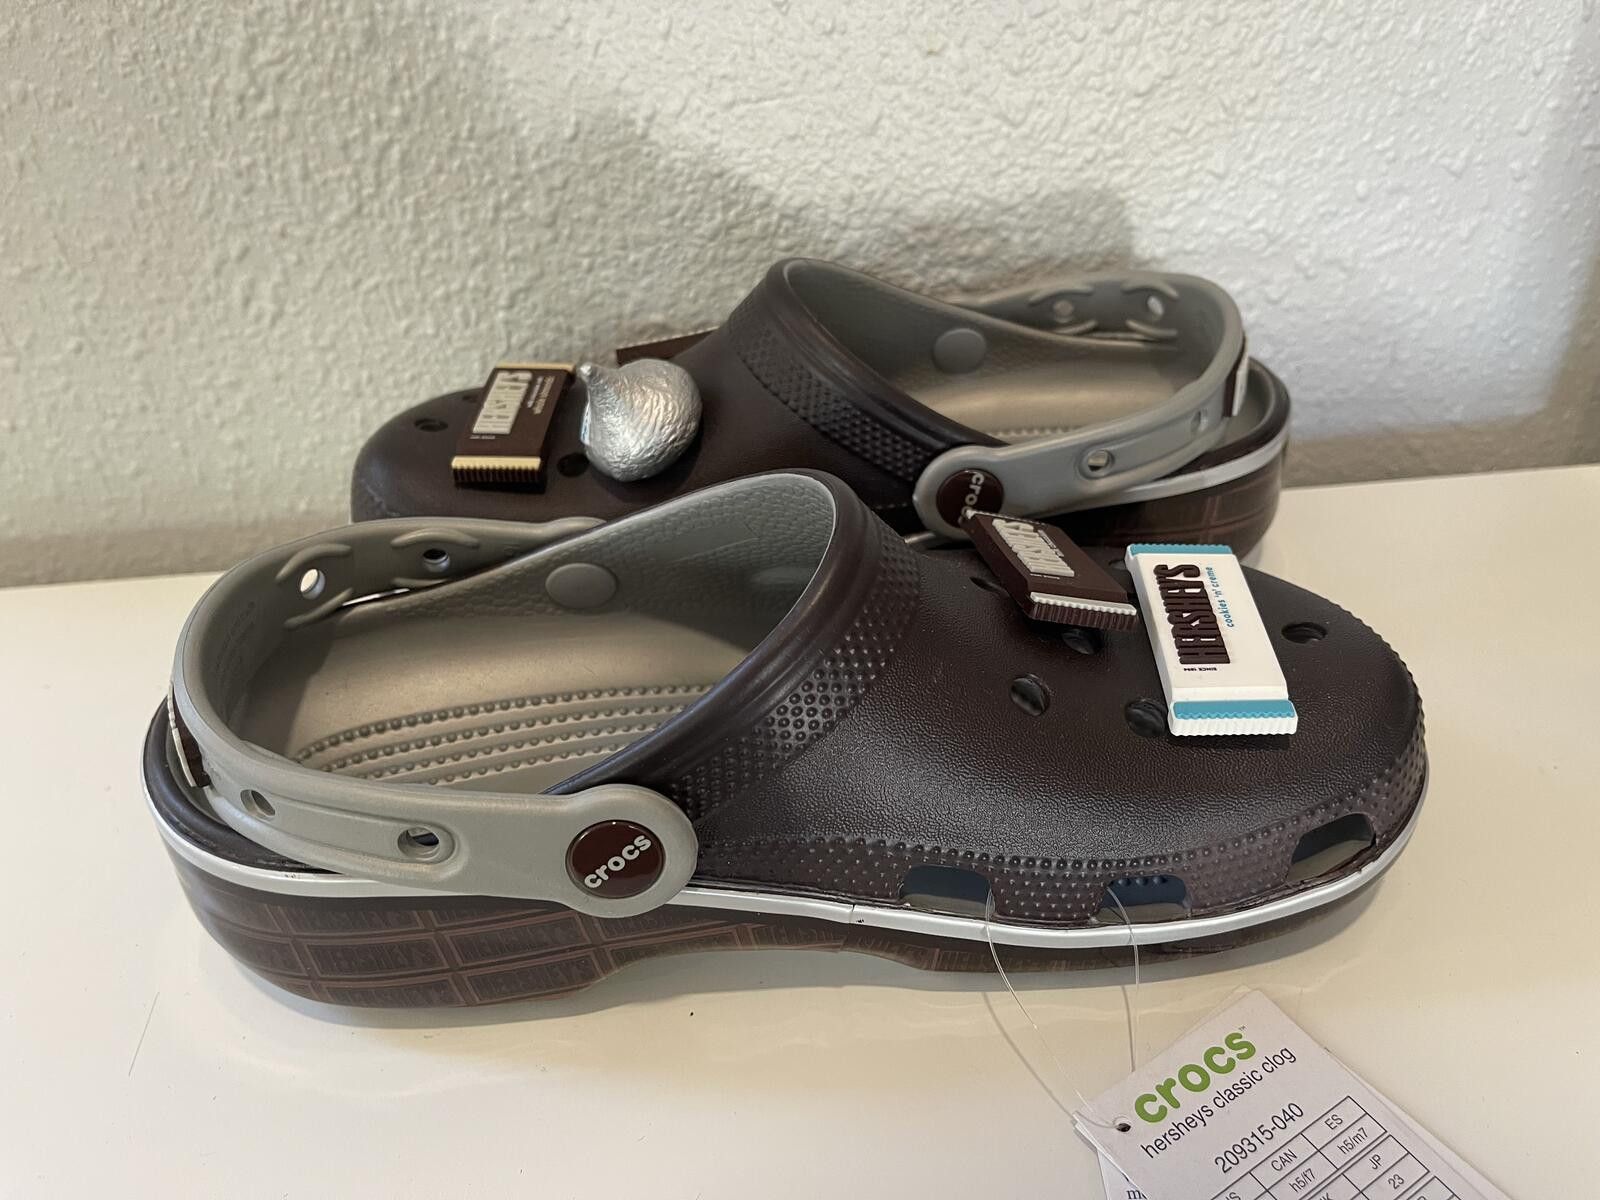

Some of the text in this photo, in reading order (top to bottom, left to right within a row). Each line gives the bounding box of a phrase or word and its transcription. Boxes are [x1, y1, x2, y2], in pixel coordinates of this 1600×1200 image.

[958, 473, 985, 524] croc
[1206, 567, 1220, 587] creme
[1218, 600, 1235, 628] cookies
[584, 835, 652, 888] crocs
[1134, 1032, 1257, 1123] crocs
[1140, 1047, 1297, 1159] hersheys classic clog
[1214, 1102, 1304, 1173] 209315-040
[1270, 1149, 1298, 1171] CAN
[1324, 1114, 1343, 1130] ES
[1337, 1127, 1369, 1154] h5/m7
[1368, 1154, 1383, 1170] JP
[1388, 1173, 1405, 1190] 23
